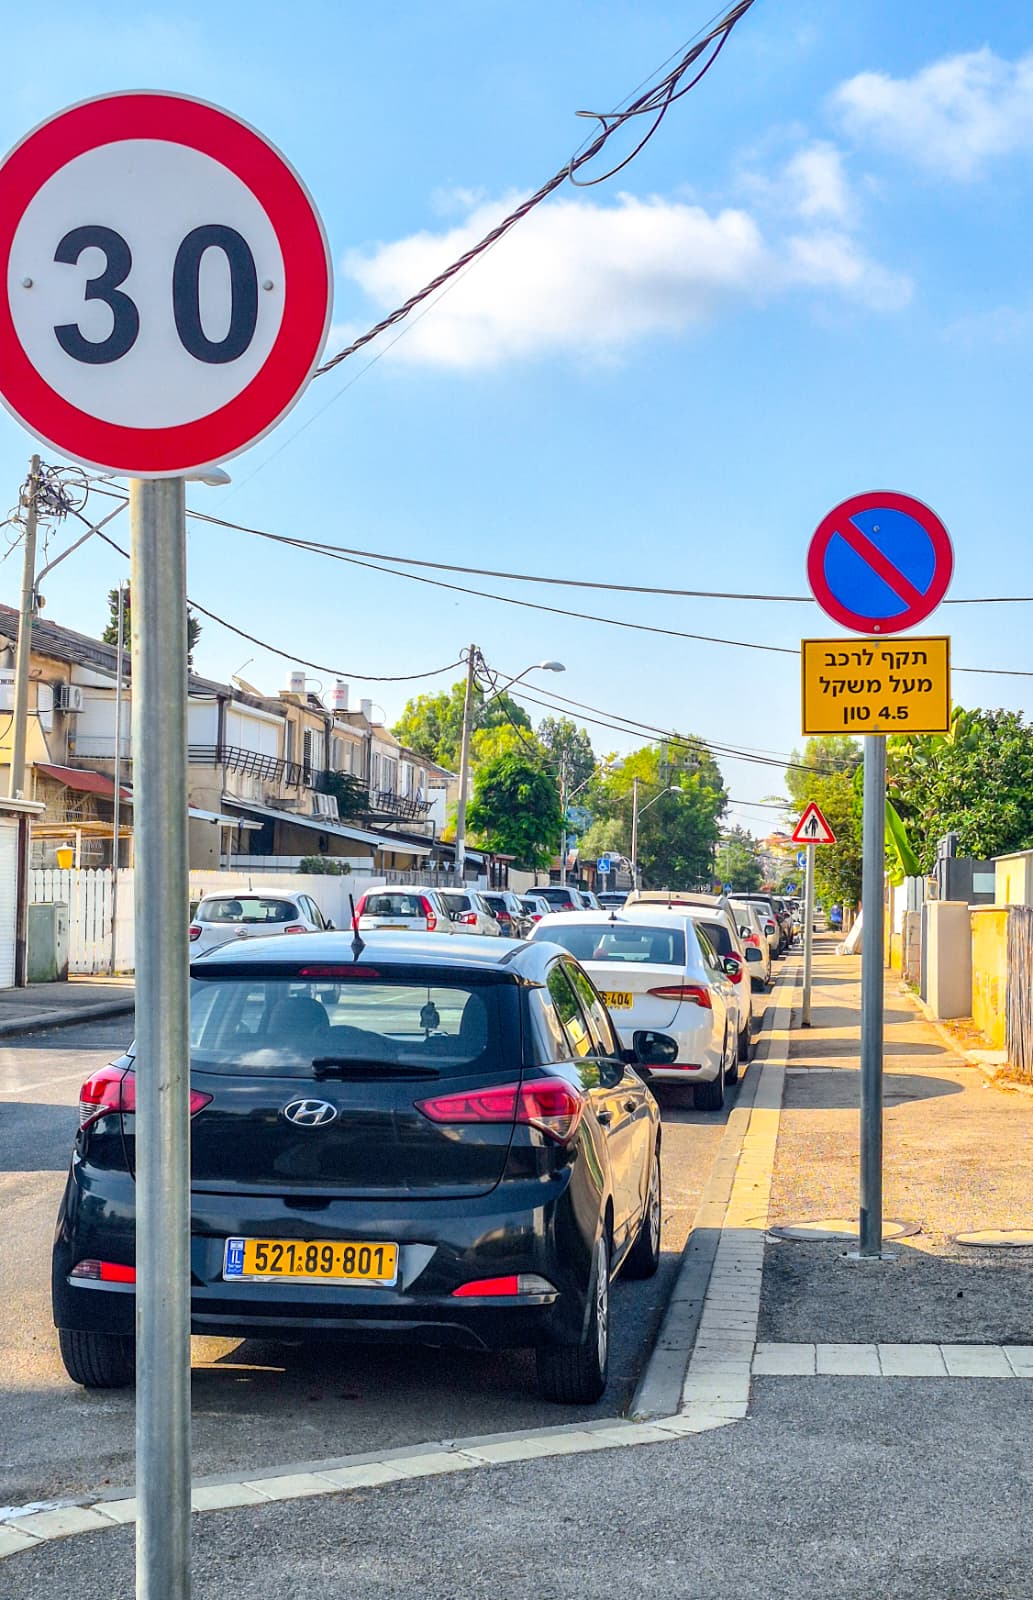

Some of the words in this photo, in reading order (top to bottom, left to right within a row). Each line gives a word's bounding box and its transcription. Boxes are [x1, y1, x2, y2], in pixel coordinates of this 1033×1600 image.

[53, 224, 259, 365] 30
[824, 649, 874, 667] לרכב
[881, 651, 927, 670] תקף
[819, 676, 882, 697] משקל
[889, 675, 933, 694] מעל
[843, 706, 871, 724] טון
[878, 706, 909, 720] 4.5
[231, 1250, 241, 1264] IL
